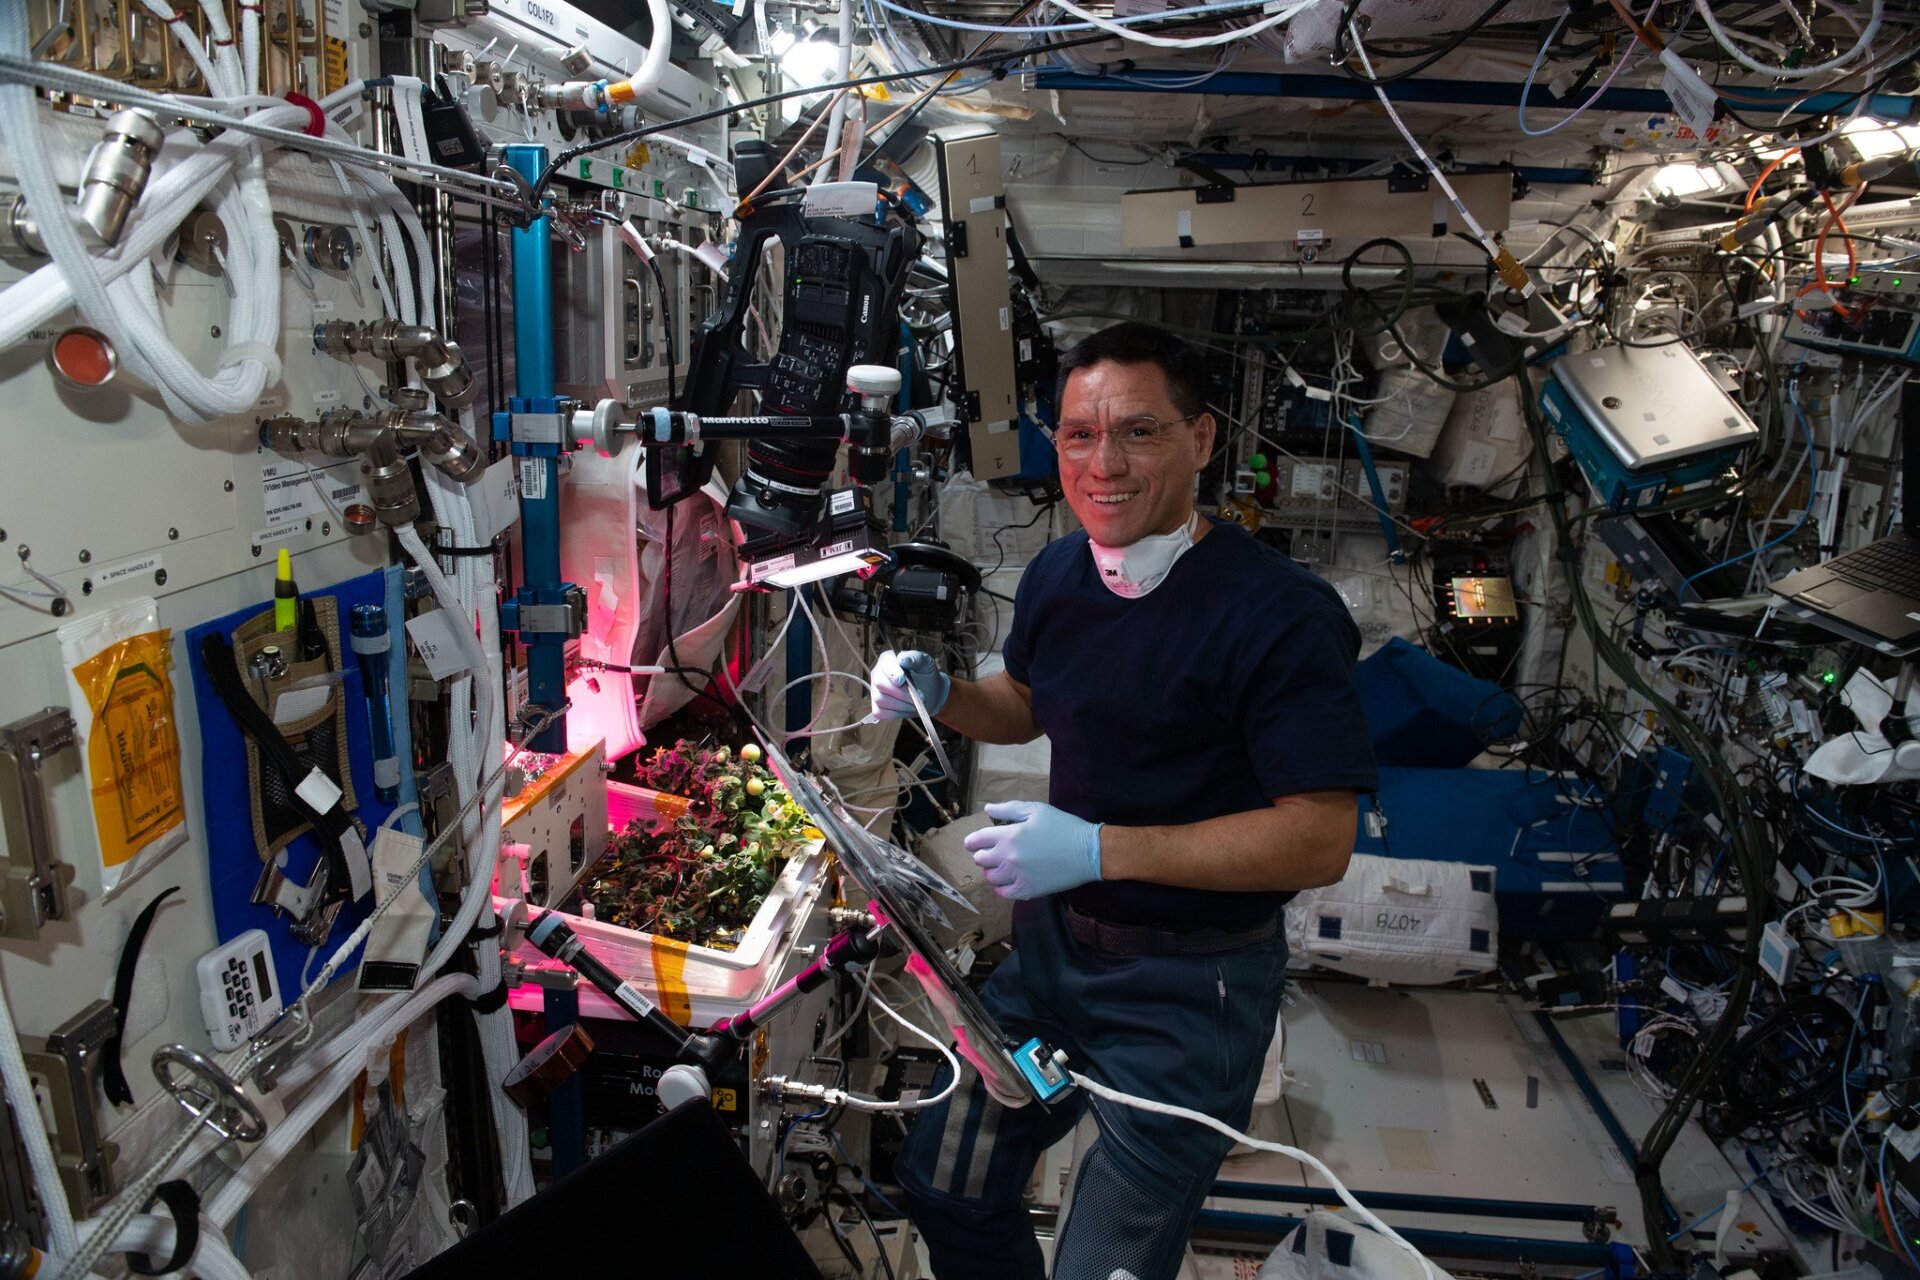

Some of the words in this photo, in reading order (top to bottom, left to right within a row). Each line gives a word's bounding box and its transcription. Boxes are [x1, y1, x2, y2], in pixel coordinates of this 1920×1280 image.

[527, 1, 554, 26] COL1F2
[966, 152, 981, 176] 1
[1302, 193, 1315, 216] 2
[861, 294, 870, 324] Canon
[702, 416, 769, 425] Manfrotto
[262, 467, 277, 477] VMU
[264, 482, 281, 494] (Video
[273, 528, 287, 537] HANDLE
[110, 568, 127, 579] SPACE
[128, 562, 148, 573] HANDLE
[1105, 569, 1118, 577] 3M
[1377, 911, 1421, 930] 4078
